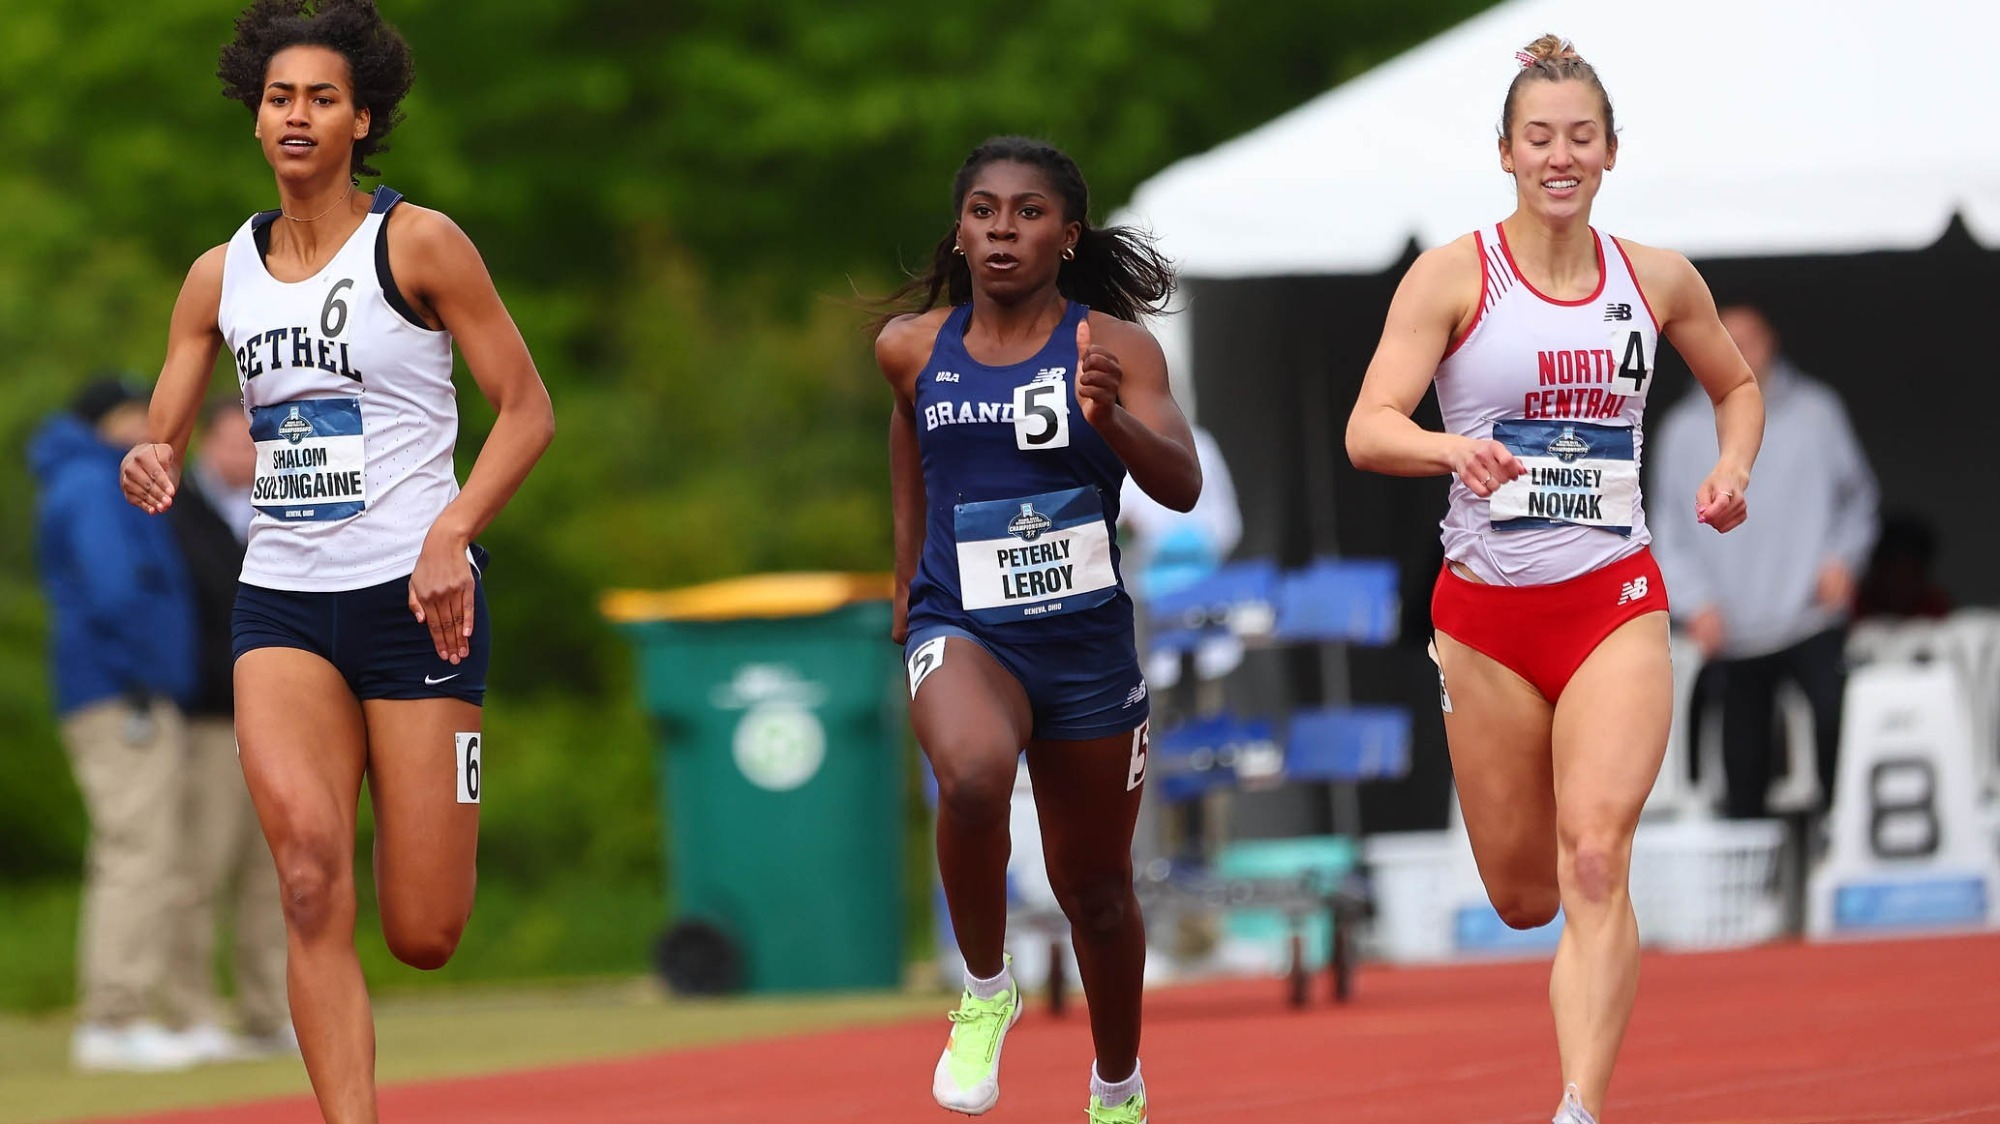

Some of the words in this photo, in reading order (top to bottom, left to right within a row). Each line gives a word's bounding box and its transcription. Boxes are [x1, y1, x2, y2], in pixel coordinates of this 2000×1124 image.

[319, 278, 354, 339] 6
[236, 326, 363, 387] BETHEL
[1618, 330, 1648, 392] 4
[935, 371, 960, 383] UAA
[1024, 385, 1059, 445] 5
[1524, 388, 1627, 419] CENTRAL
[273, 447, 327, 470] SHALOM
[1530, 467, 1602, 489] LINDSEY
[1528, 491, 1603, 520] NOVAK
[997, 539, 1070, 569] PETERLY
[1002, 564, 1074, 600] LEROY
[1023, 604, 1048, 616] GENEVA,
[1047, 602, 1062, 613] OHIO
[912, 641, 936, 689] 5
[465, 736, 479, 800] 6
[1870, 758, 1939, 860] 8
